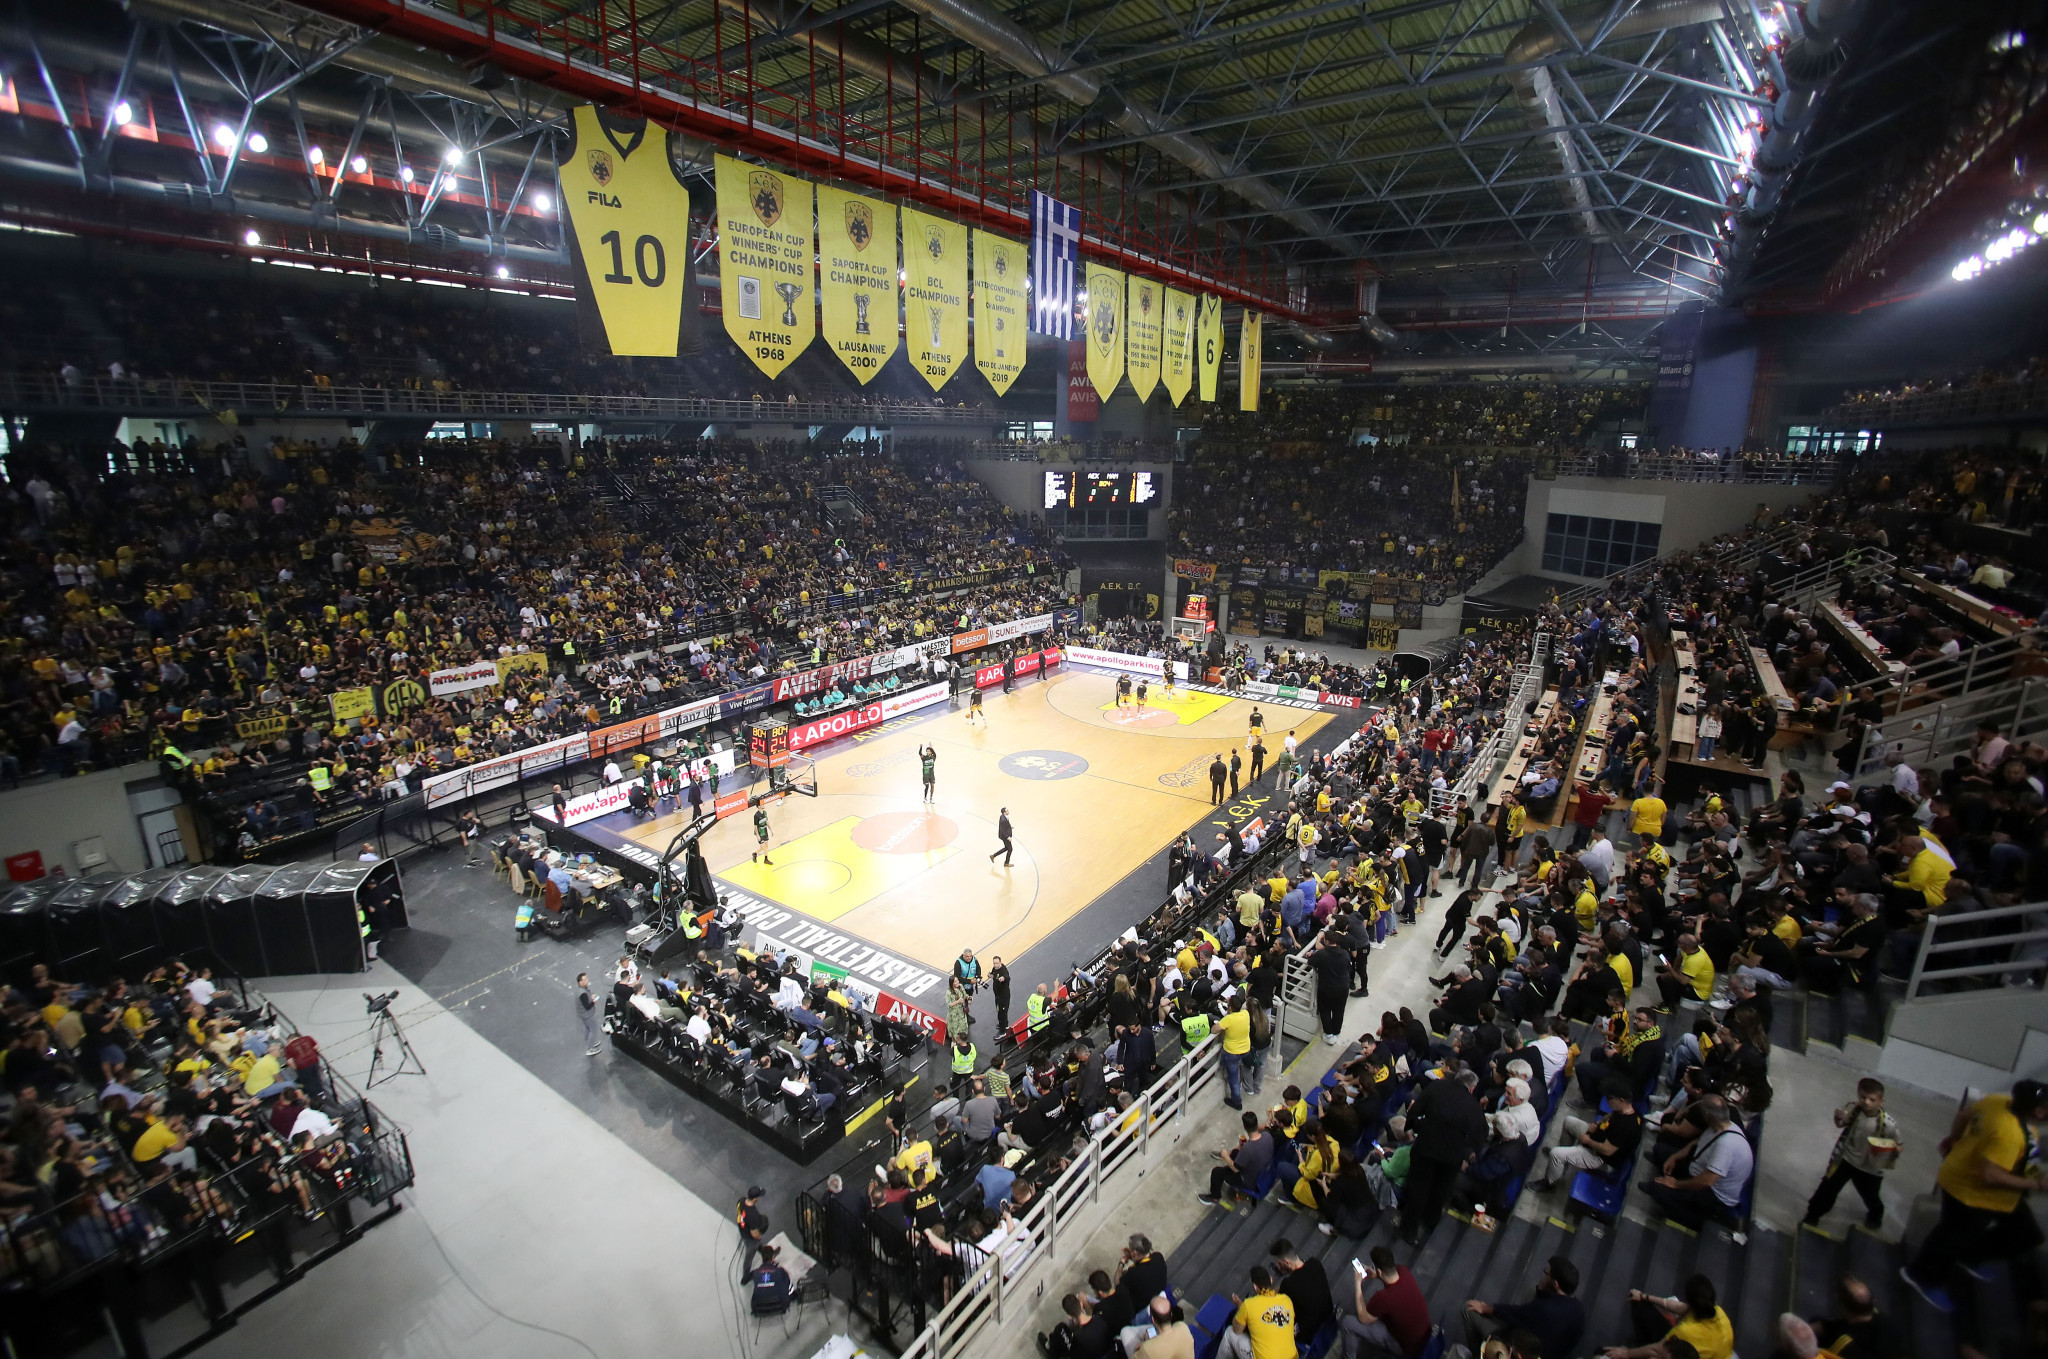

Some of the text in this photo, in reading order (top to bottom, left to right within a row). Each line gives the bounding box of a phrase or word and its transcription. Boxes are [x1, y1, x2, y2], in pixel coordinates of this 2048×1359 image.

[588, 191, 622, 208] FILA
[728, 220, 805, 246] EUROPEAN CUP
[601, 230, 666, 287] 10
[784, 248, 802, 260] CUP
[730, 251, 804, 276] CHAMPIONS
[832, 258, 888, 276] SAPORTA CUP
[830, 270, 890, 290] CHAMPIONS
[928, 276, 944, 289] BCL
[910, 288, 960, 306] CHAMPIONS
[986, 304, 1016, 314] CHAMPIONS
[748, 330, 792, 346] ATHENS
[756, 347, 785, 361] 1968
[838, 341, 886, 354] LAUSANNE
[1206, 338, 1214, 364] 6
[1248, 344, 1254, 360] 13
[851, 356, 877, 368] 2000
[921, 352, 951, 364] ATHENS
[978, 360, 990, 368] RIO
[926, 365, 946, 376] 2018
[992, 372, 1008, 382] 2019
[1659, 366, 1682, 374] Allianz
[1070, 392, 1097, 402] AVIS
[1188, 602, 1198, 610] 24
[996, 626, 1019, 638] SUNEL
[956, 633, 986, 646] betsson
[778, 660, 867, 700] AVIS AVIS
[1264, 696, 1326, 710] LEAGUE
[1324, 694, 1354, 707] AVIS
[805, 706, 880, 742] APOLLO
[852, 715, 925, 742] ATHENS
[597, 722, 654, 748] betsson
[752, 737, 766, 752] 24
[770, 736, 787, 752] 24
[716, 798, 746, 813] betsson
[1304, 831, 1309, 840] 9
[779, 920, 943, 998] BASKETBALL
[886, 1000, 935, 1030] AVIS
[1188, 1023, 1206, 1032] ALFA
